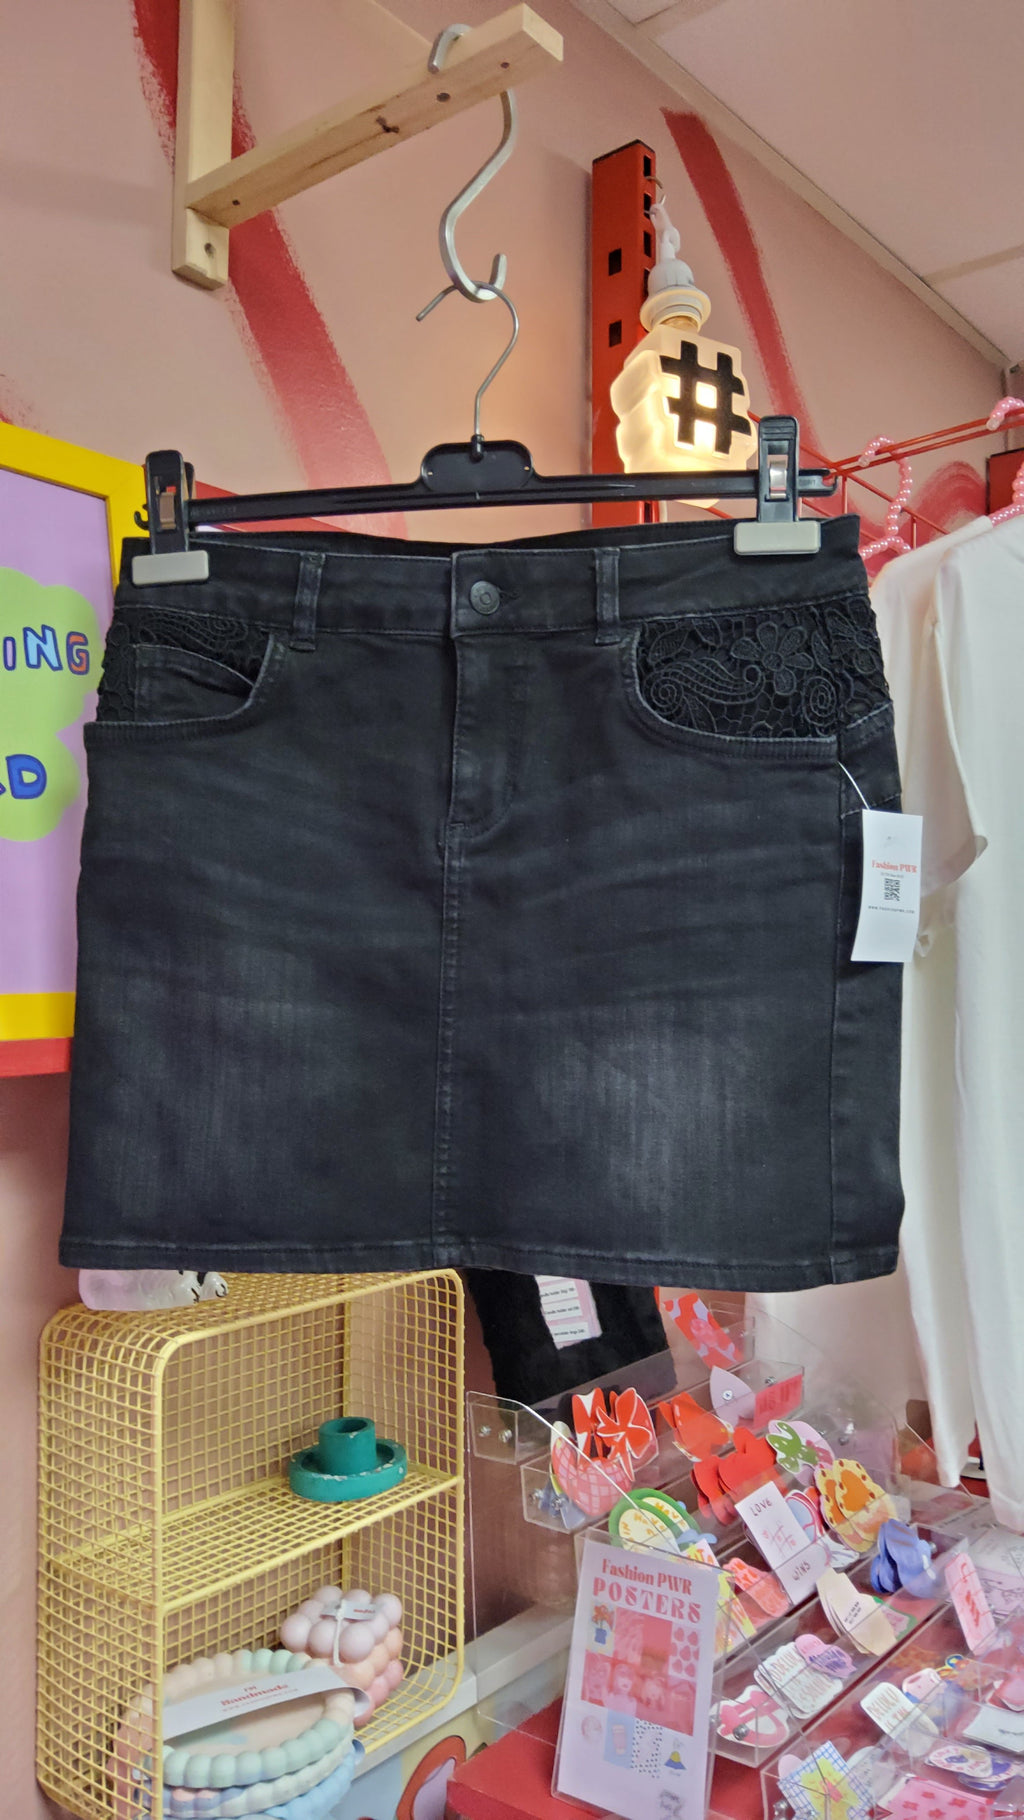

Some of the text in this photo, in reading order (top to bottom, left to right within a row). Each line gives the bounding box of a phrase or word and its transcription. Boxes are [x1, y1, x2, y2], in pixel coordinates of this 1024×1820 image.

[3, 624, 90, 675] ING
[749, 1497, 773, 1517] LOVE
[601, 1558, 692, 1596] Fashion PWR
[792, 1561, 811, 1581] WINS
[593, 1576, 702, 1625] POSTERS
